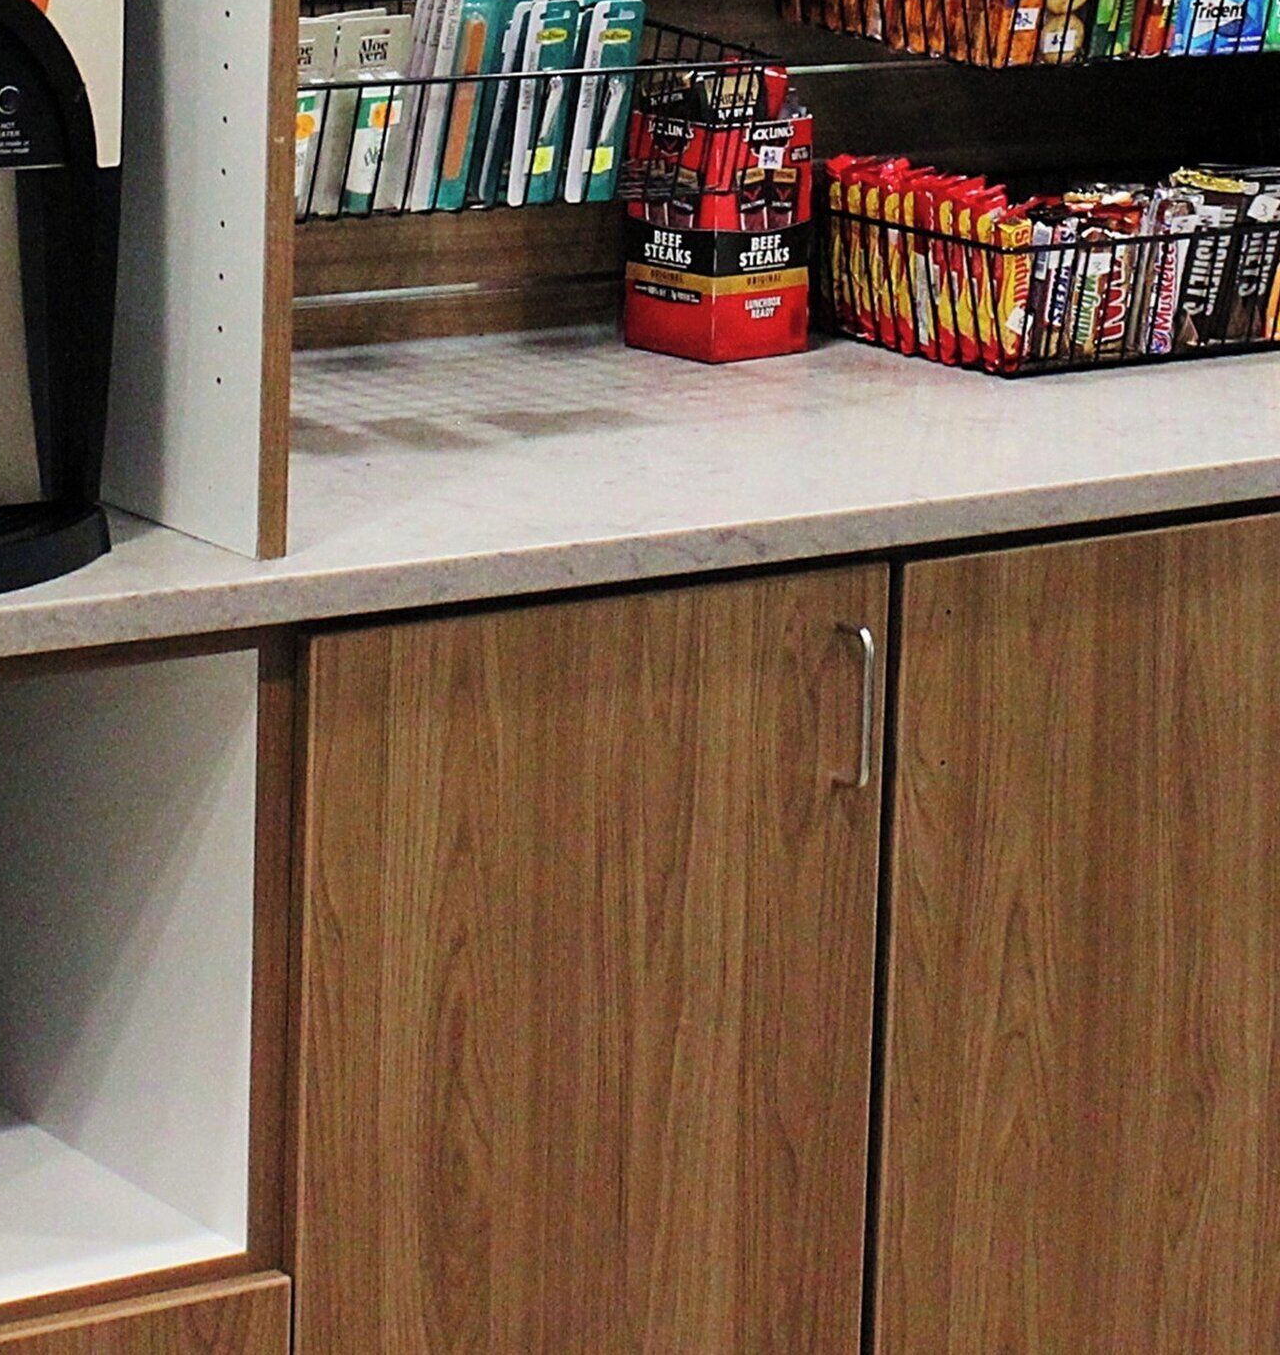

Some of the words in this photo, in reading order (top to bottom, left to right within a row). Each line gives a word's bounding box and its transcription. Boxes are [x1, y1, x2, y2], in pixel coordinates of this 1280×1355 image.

[360, 38, 389, 52] Aloe
[653, 229, 683, 247] BEEF
[751, 234, 782, 252] BEEF
[644, 243, 692, 265] STEAKS
[739, 246, 790, 267] STEAKS
